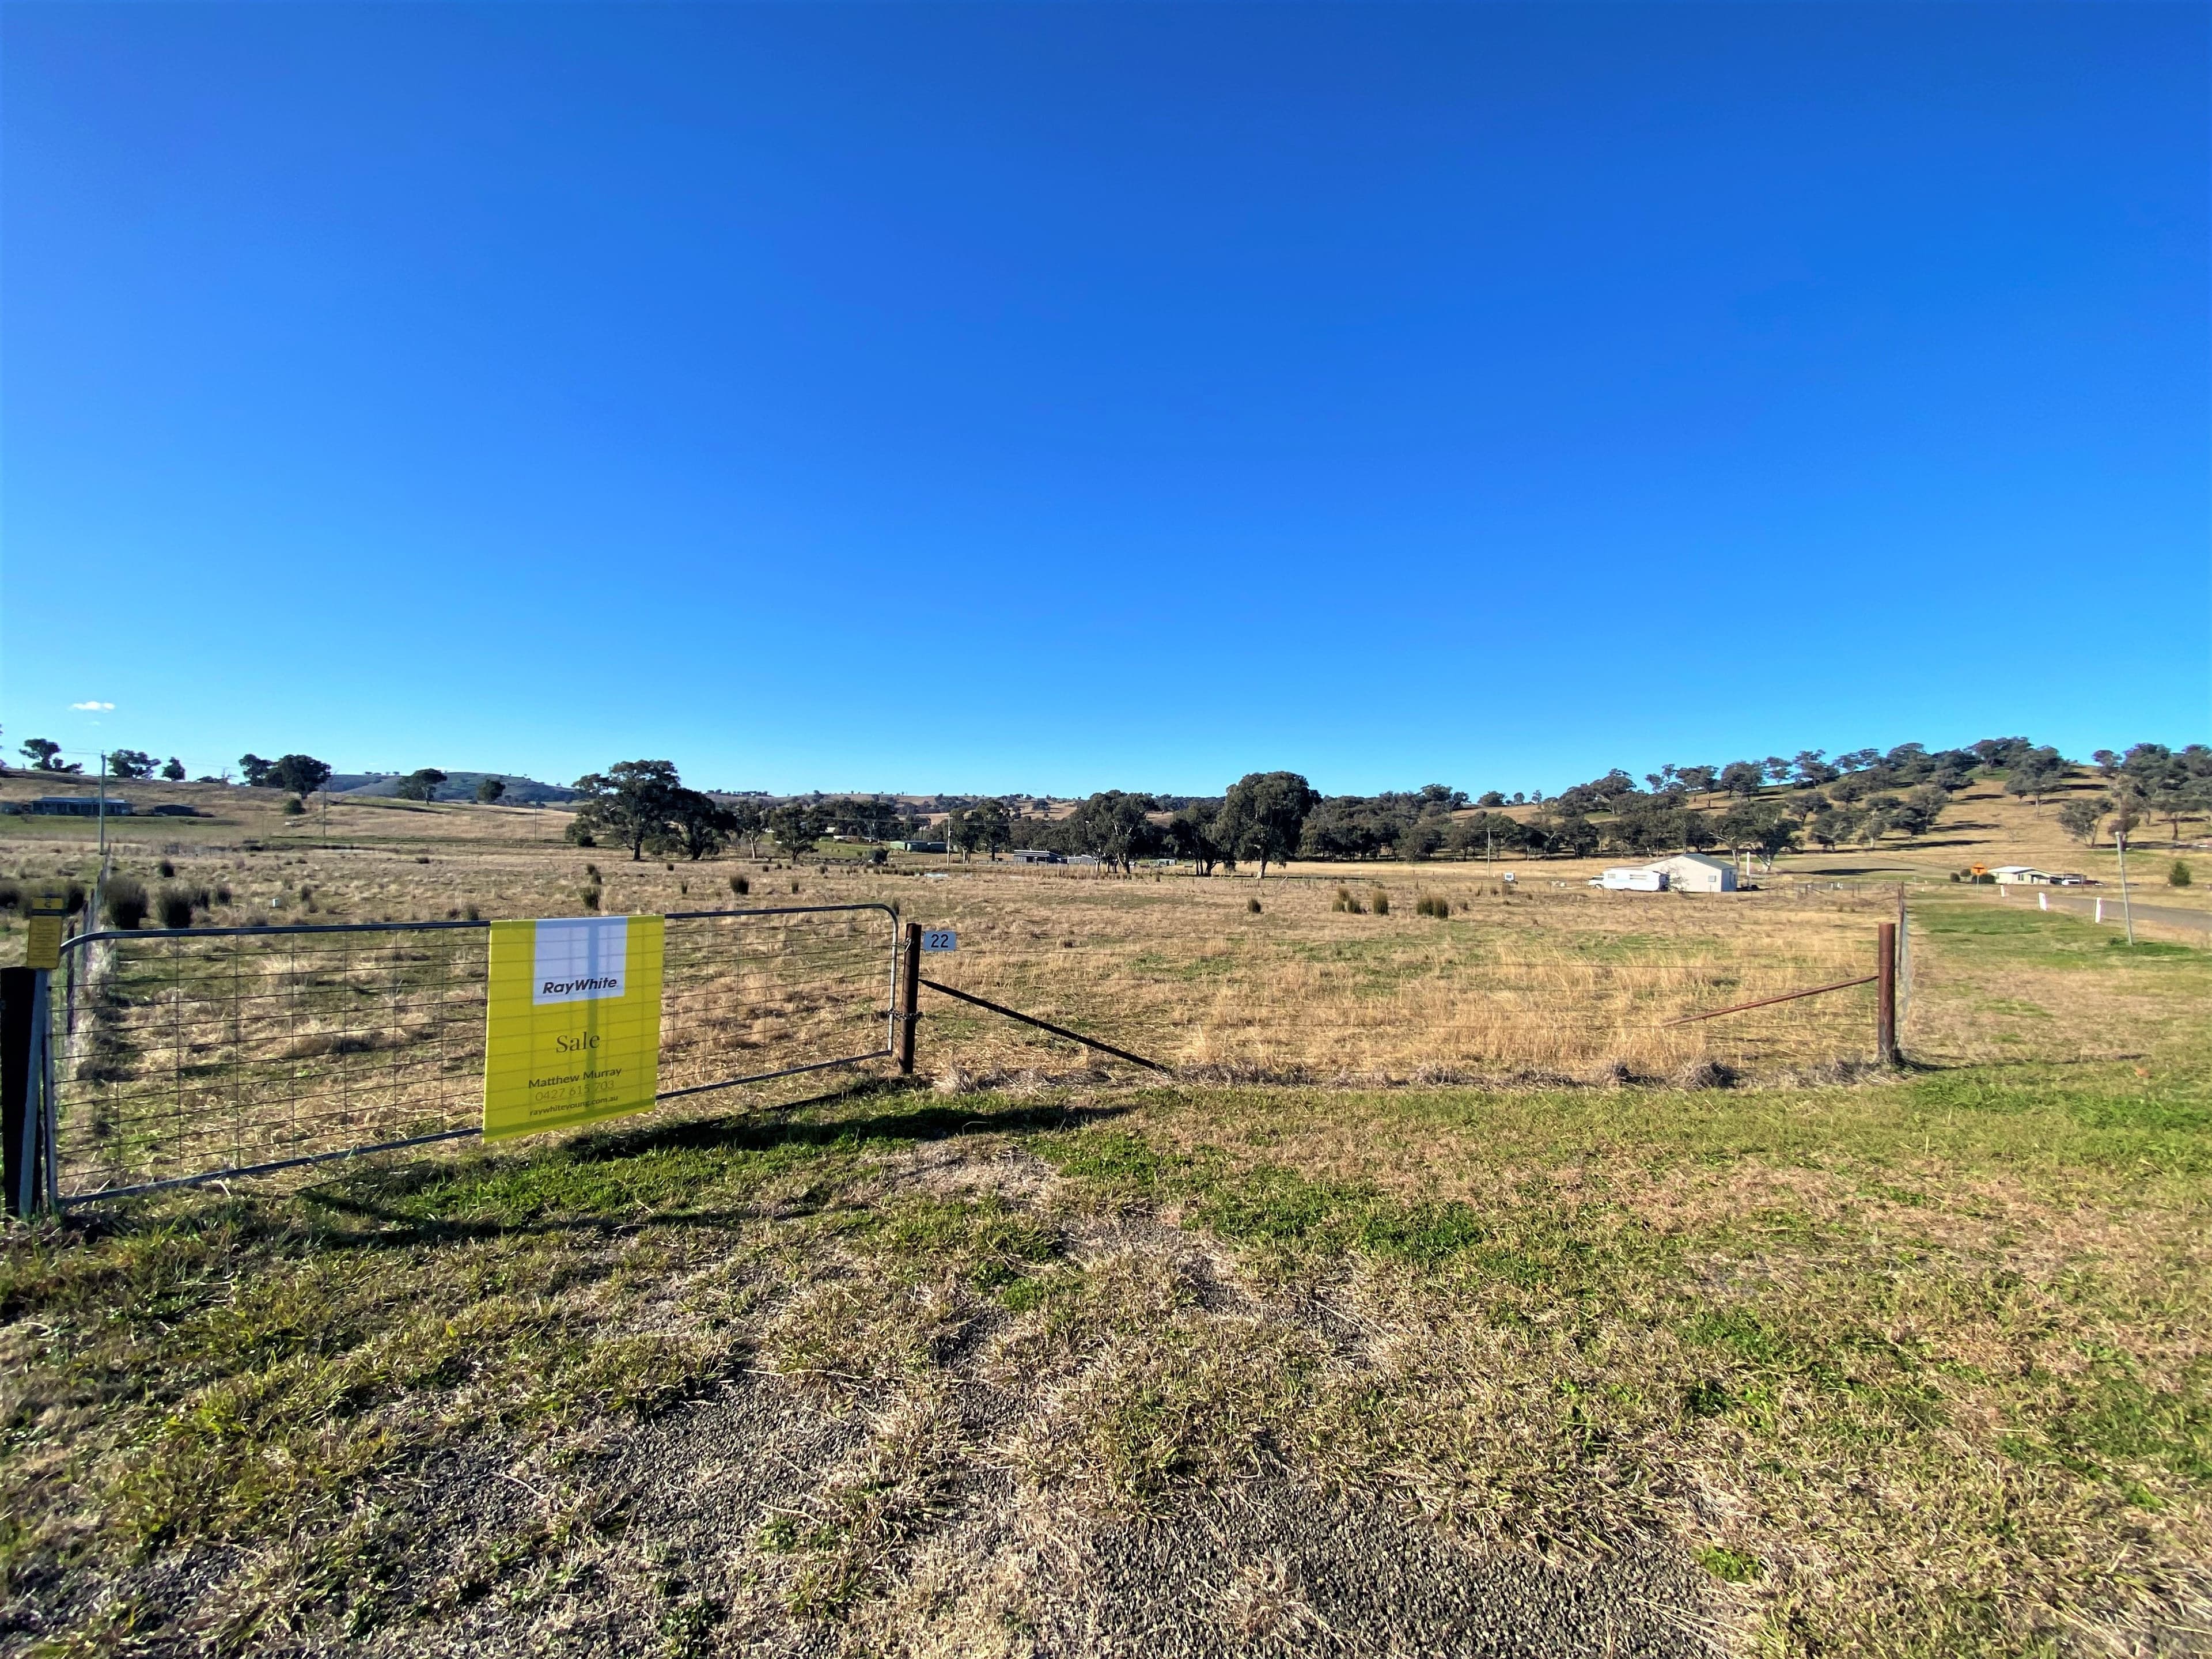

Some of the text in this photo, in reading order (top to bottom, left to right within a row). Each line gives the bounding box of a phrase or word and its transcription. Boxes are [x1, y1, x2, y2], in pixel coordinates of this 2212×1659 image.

[931, 934, 949, 948] 22
[556, 1031, 600, 1053] Sale
[528, 1068, 622, 1088] Matthew Murray
[535, 1080, 614, 1101] 0427 615 703
[529, 1096, 619, 1116] raywhiteyoung.com.au
